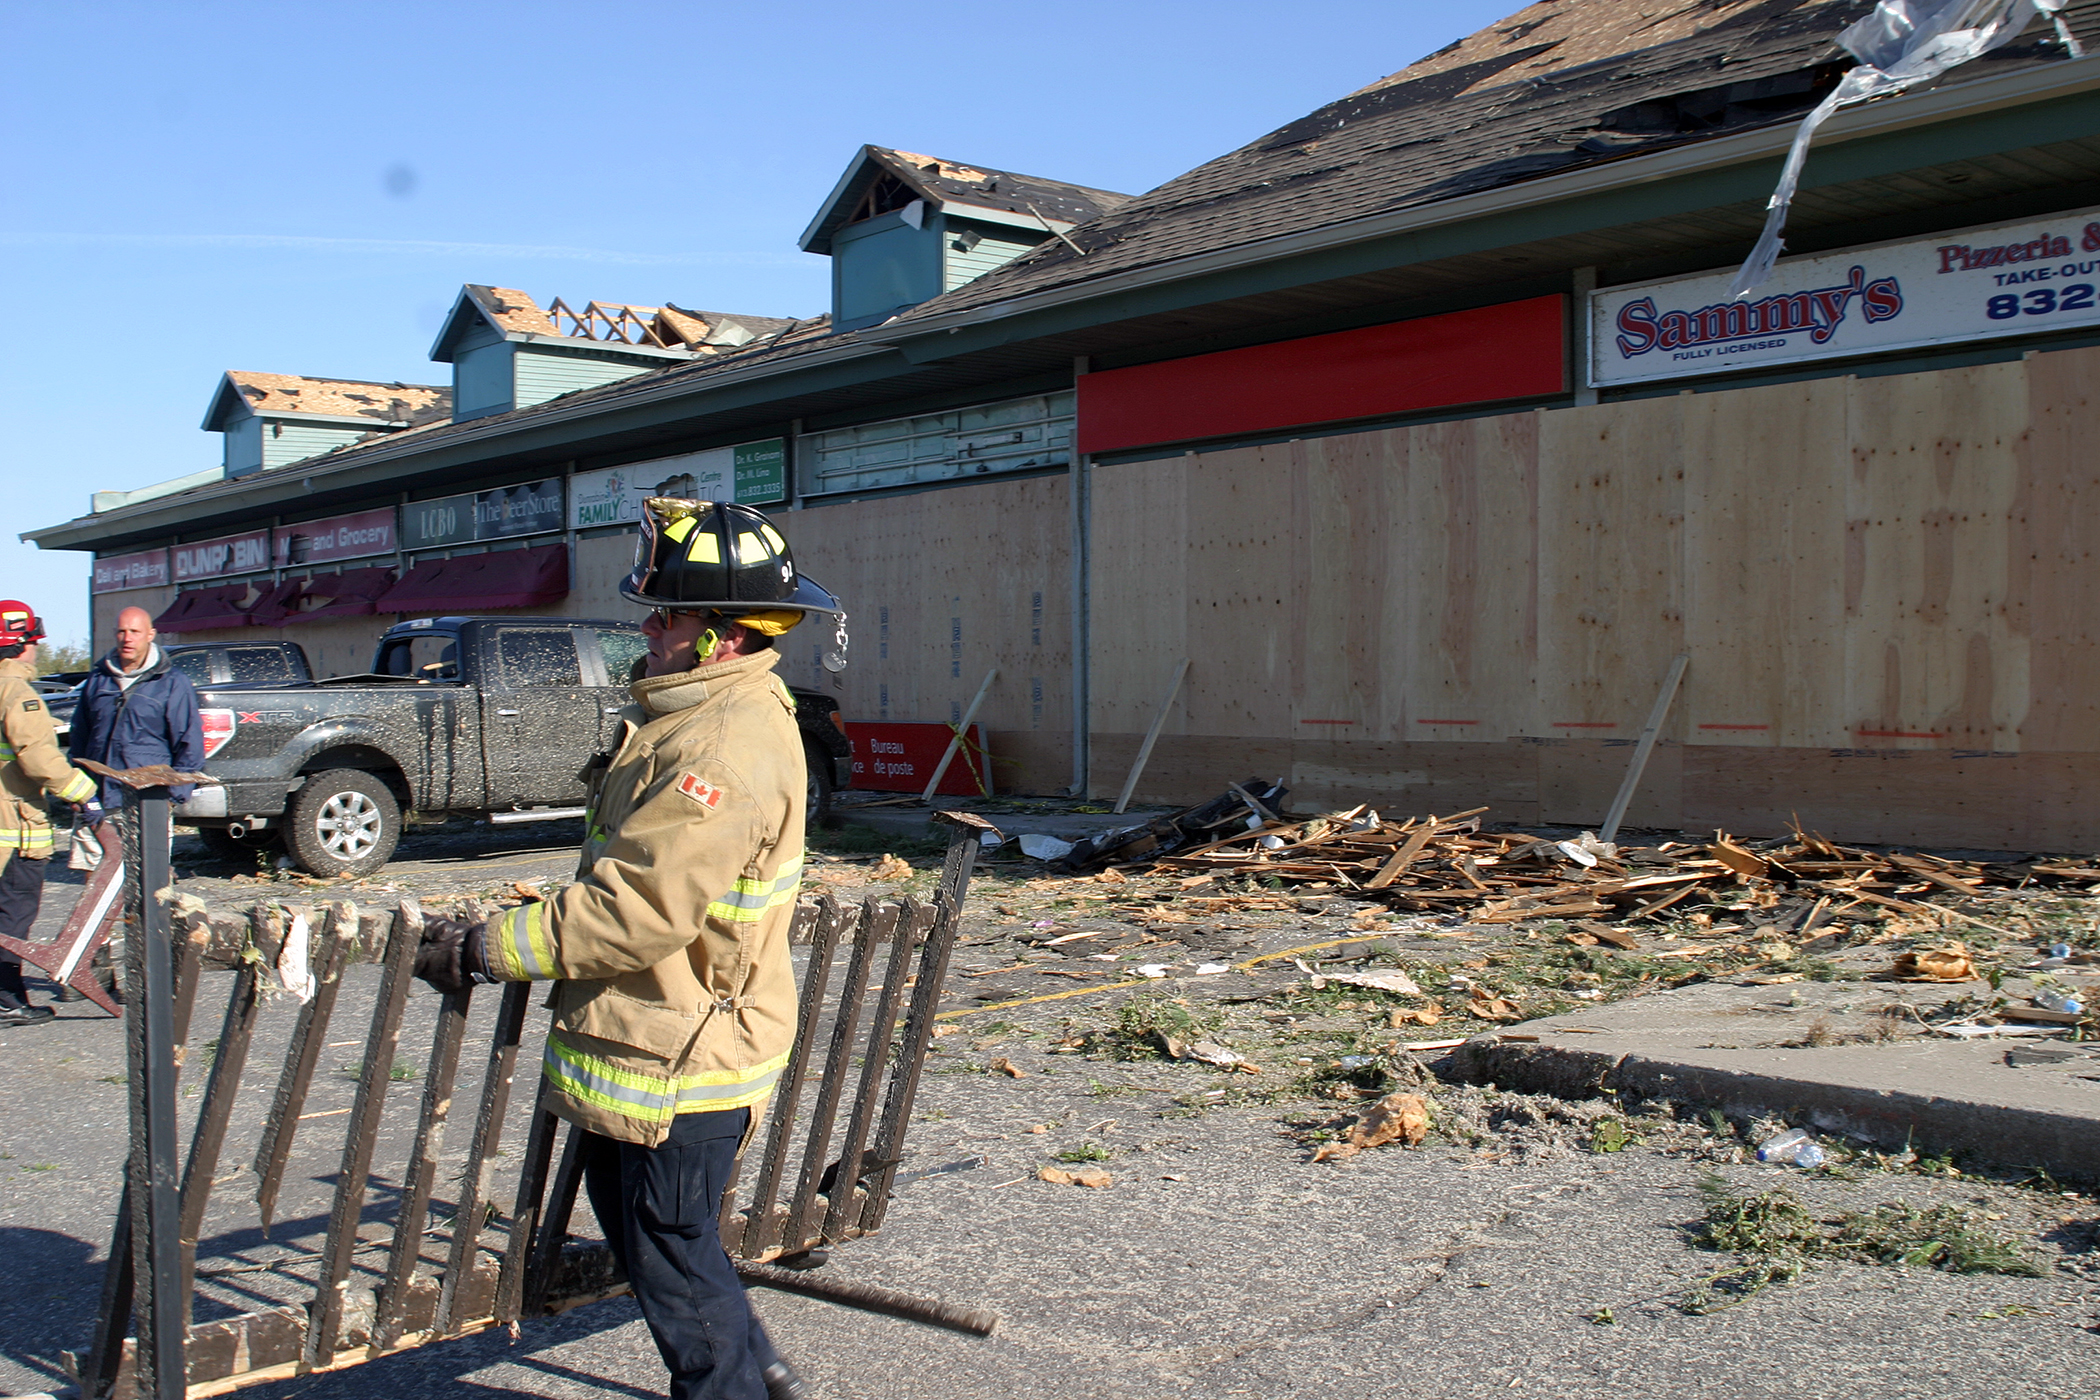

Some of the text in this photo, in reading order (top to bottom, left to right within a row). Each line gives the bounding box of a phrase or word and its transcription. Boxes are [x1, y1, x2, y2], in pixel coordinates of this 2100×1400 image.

[1937, 221, 2100, 274] Pizzeria &
[1616, 265, 1903, 359] Sammy's
[1672, 338, 1787, 361] FULLY LICENSED
[478, 492, 560, 522] The Beer Store
[578, 498, 621, 525] FAMILY
[420, 506, 456, 539] LCBO
[313, 529, 335, 551] and
[338, 526, 389, 547] Grocery
[176, 537, 265, 577] DUNRBIN
[113, 565, 130, 581] and
[132, 562, 166, 579] Bakery
[781, 560, 793, 583] 91
[236, 710, 302, 724] XTR
[870, 738, 904, 754] Bureau
[874, 758, 886, 774] de
[887, 761, 914, 778] poste
